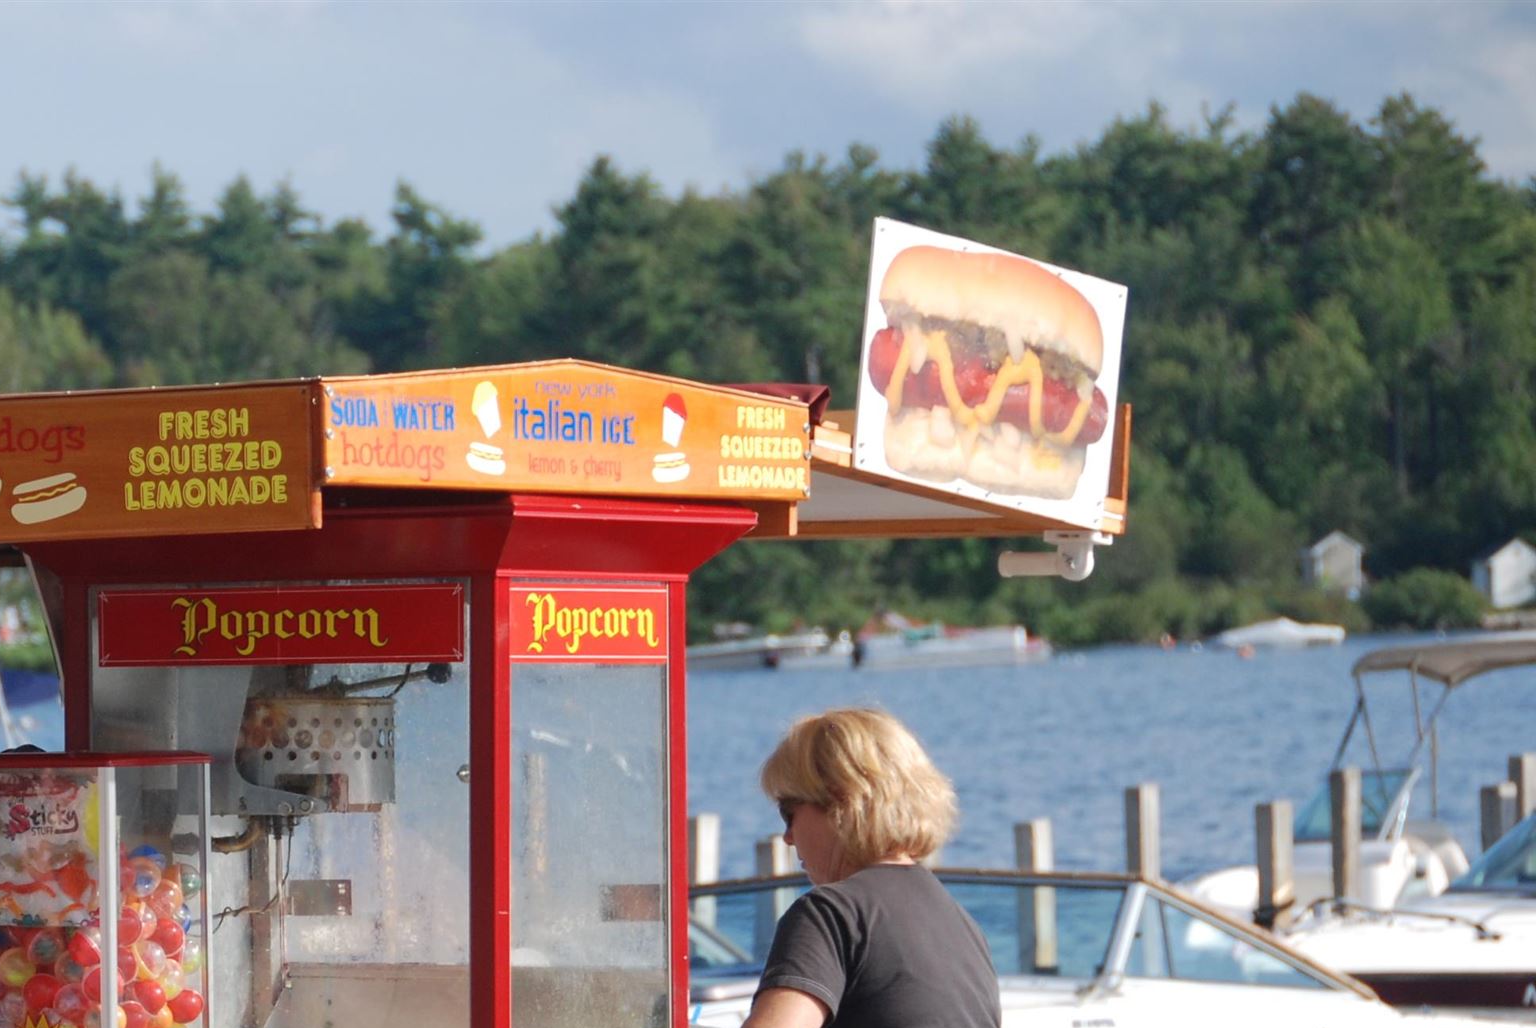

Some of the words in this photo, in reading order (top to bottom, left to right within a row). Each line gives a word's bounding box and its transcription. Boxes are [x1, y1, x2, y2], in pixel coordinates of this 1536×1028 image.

[535, 382, 572, 396] new
[158, 407, 249, 440] FRESH
[330, 397, 379, 427] SODA
[392, 399, 455, 431] WATER
[514, 397, 592, 442] italian
[736, 405, 785, 430] FRESH
[128, 440, 283, 477] SQUEEZED
[340, 431, 445, 482] hotdogs
[720, 434, 802, 460] SQUEEZED
[528, 452, 566, 475] lemon
[570, 459, 579, 475] &
[583, 456, 622, 482] cherry
[718, 464, 805, 490] LEMONADE
[124, 474, 288, 511] LEMONADE
[170, 596, 389, 657] Popcorn
[525, 592, 659, 654] Popcorn
[9, 803, 79, 835] Sticky
